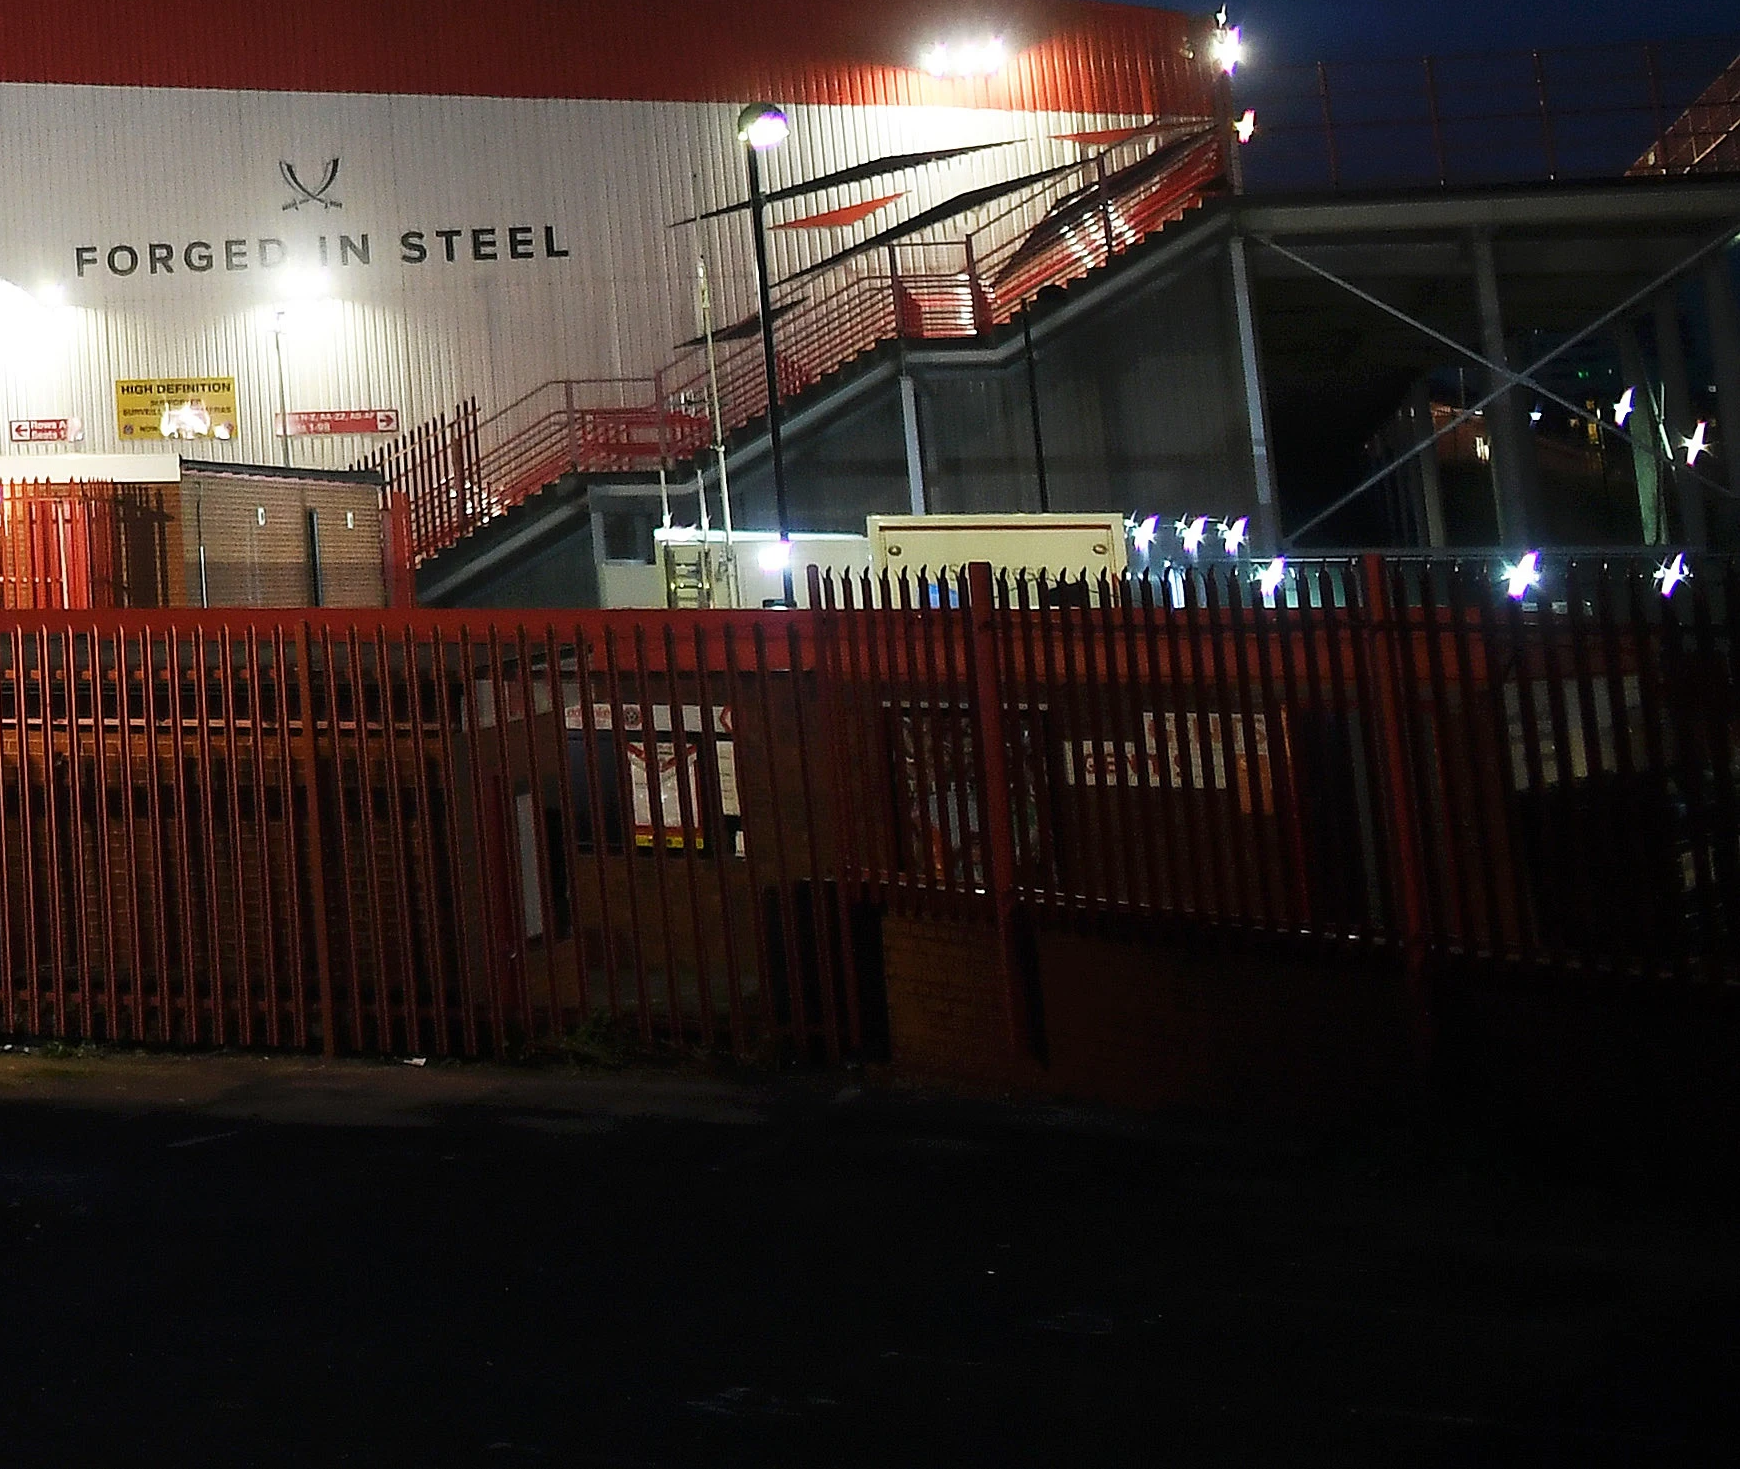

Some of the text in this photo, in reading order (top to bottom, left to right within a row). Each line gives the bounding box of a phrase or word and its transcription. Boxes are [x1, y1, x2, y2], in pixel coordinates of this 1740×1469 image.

[75, 225, 569, 277] FORGED IN STEEL
[121, 382, 231, 395] HIGH DEFINITION
